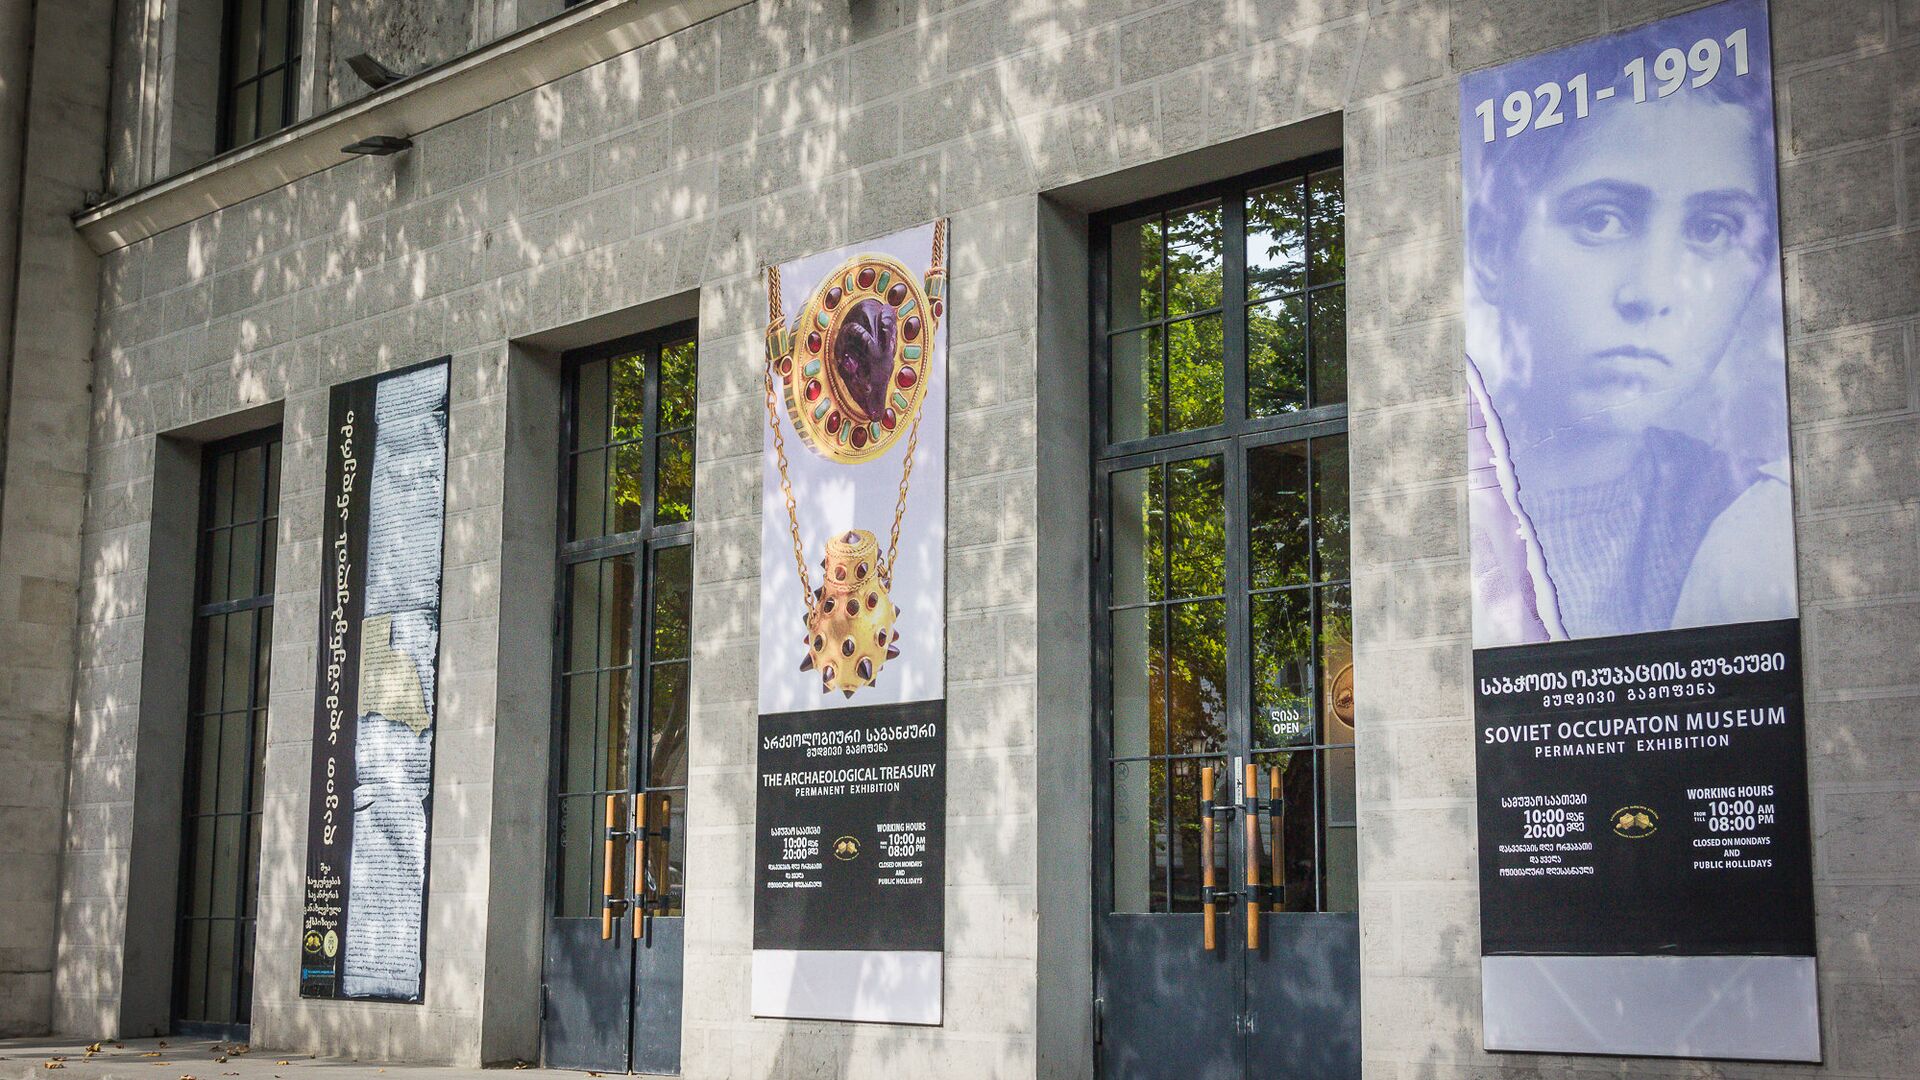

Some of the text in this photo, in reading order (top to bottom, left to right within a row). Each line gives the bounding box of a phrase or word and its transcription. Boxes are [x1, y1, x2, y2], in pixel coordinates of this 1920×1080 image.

[1475, 28, 1749, 143] 1921-1991
[1480, 652, 1785, 696] საბჭოთა ოკუპაციის მუზეუმი
[1543, 682, 1716, 707] მუდმივი გამოფენა
[1271, 709, 1299, 722] ღიაა
[1273, 722, 1300, 735] OPEN
[1485, 706, 1786, 745] SOVIET OCCUPATON MUSEUM
[763, 723, 936, 750] არქეოლოგიური საგანძური
[1535, 734, 1730, 758] PERMANENT EXHIBITION
[762, 763, 936, 787] THE ARCHAEOLOGICAL TREASURY
[795, 782, 900, 797] PERMANENT EXHIBITION
[1687, 785, 1774, 800] WORKING HOURS
[323, 757, 339, 845] დავით
[1501, 793, 1587, 808] სამუშაო საათები
[1708, 800, 1754, 816] 10:00
[1757, 804, 1774, 814] AM
[1523, 808, 1565, 823] 10:00
[877, 822, 926, 832] WORKING HOURS
[1523, 823, 1565, 838] 20:00
[1708, 816, 1755, 832] 08:00
[1758, 815, 1774, 824] PM
[783, 837, 807, 848] 10:00
[888, 833, 926, 845] 10:00 AM
[1693, 837, 1770, 847] CLOSED ON MONDAYS
[782, 848, 807, 859] 20:00
[888, 844, 926, 857] 08:00 PM
[1724, 849, 1740, 857] AND
[1694, 859, 1772, 869] PUBLIC HOLLIDAYS
